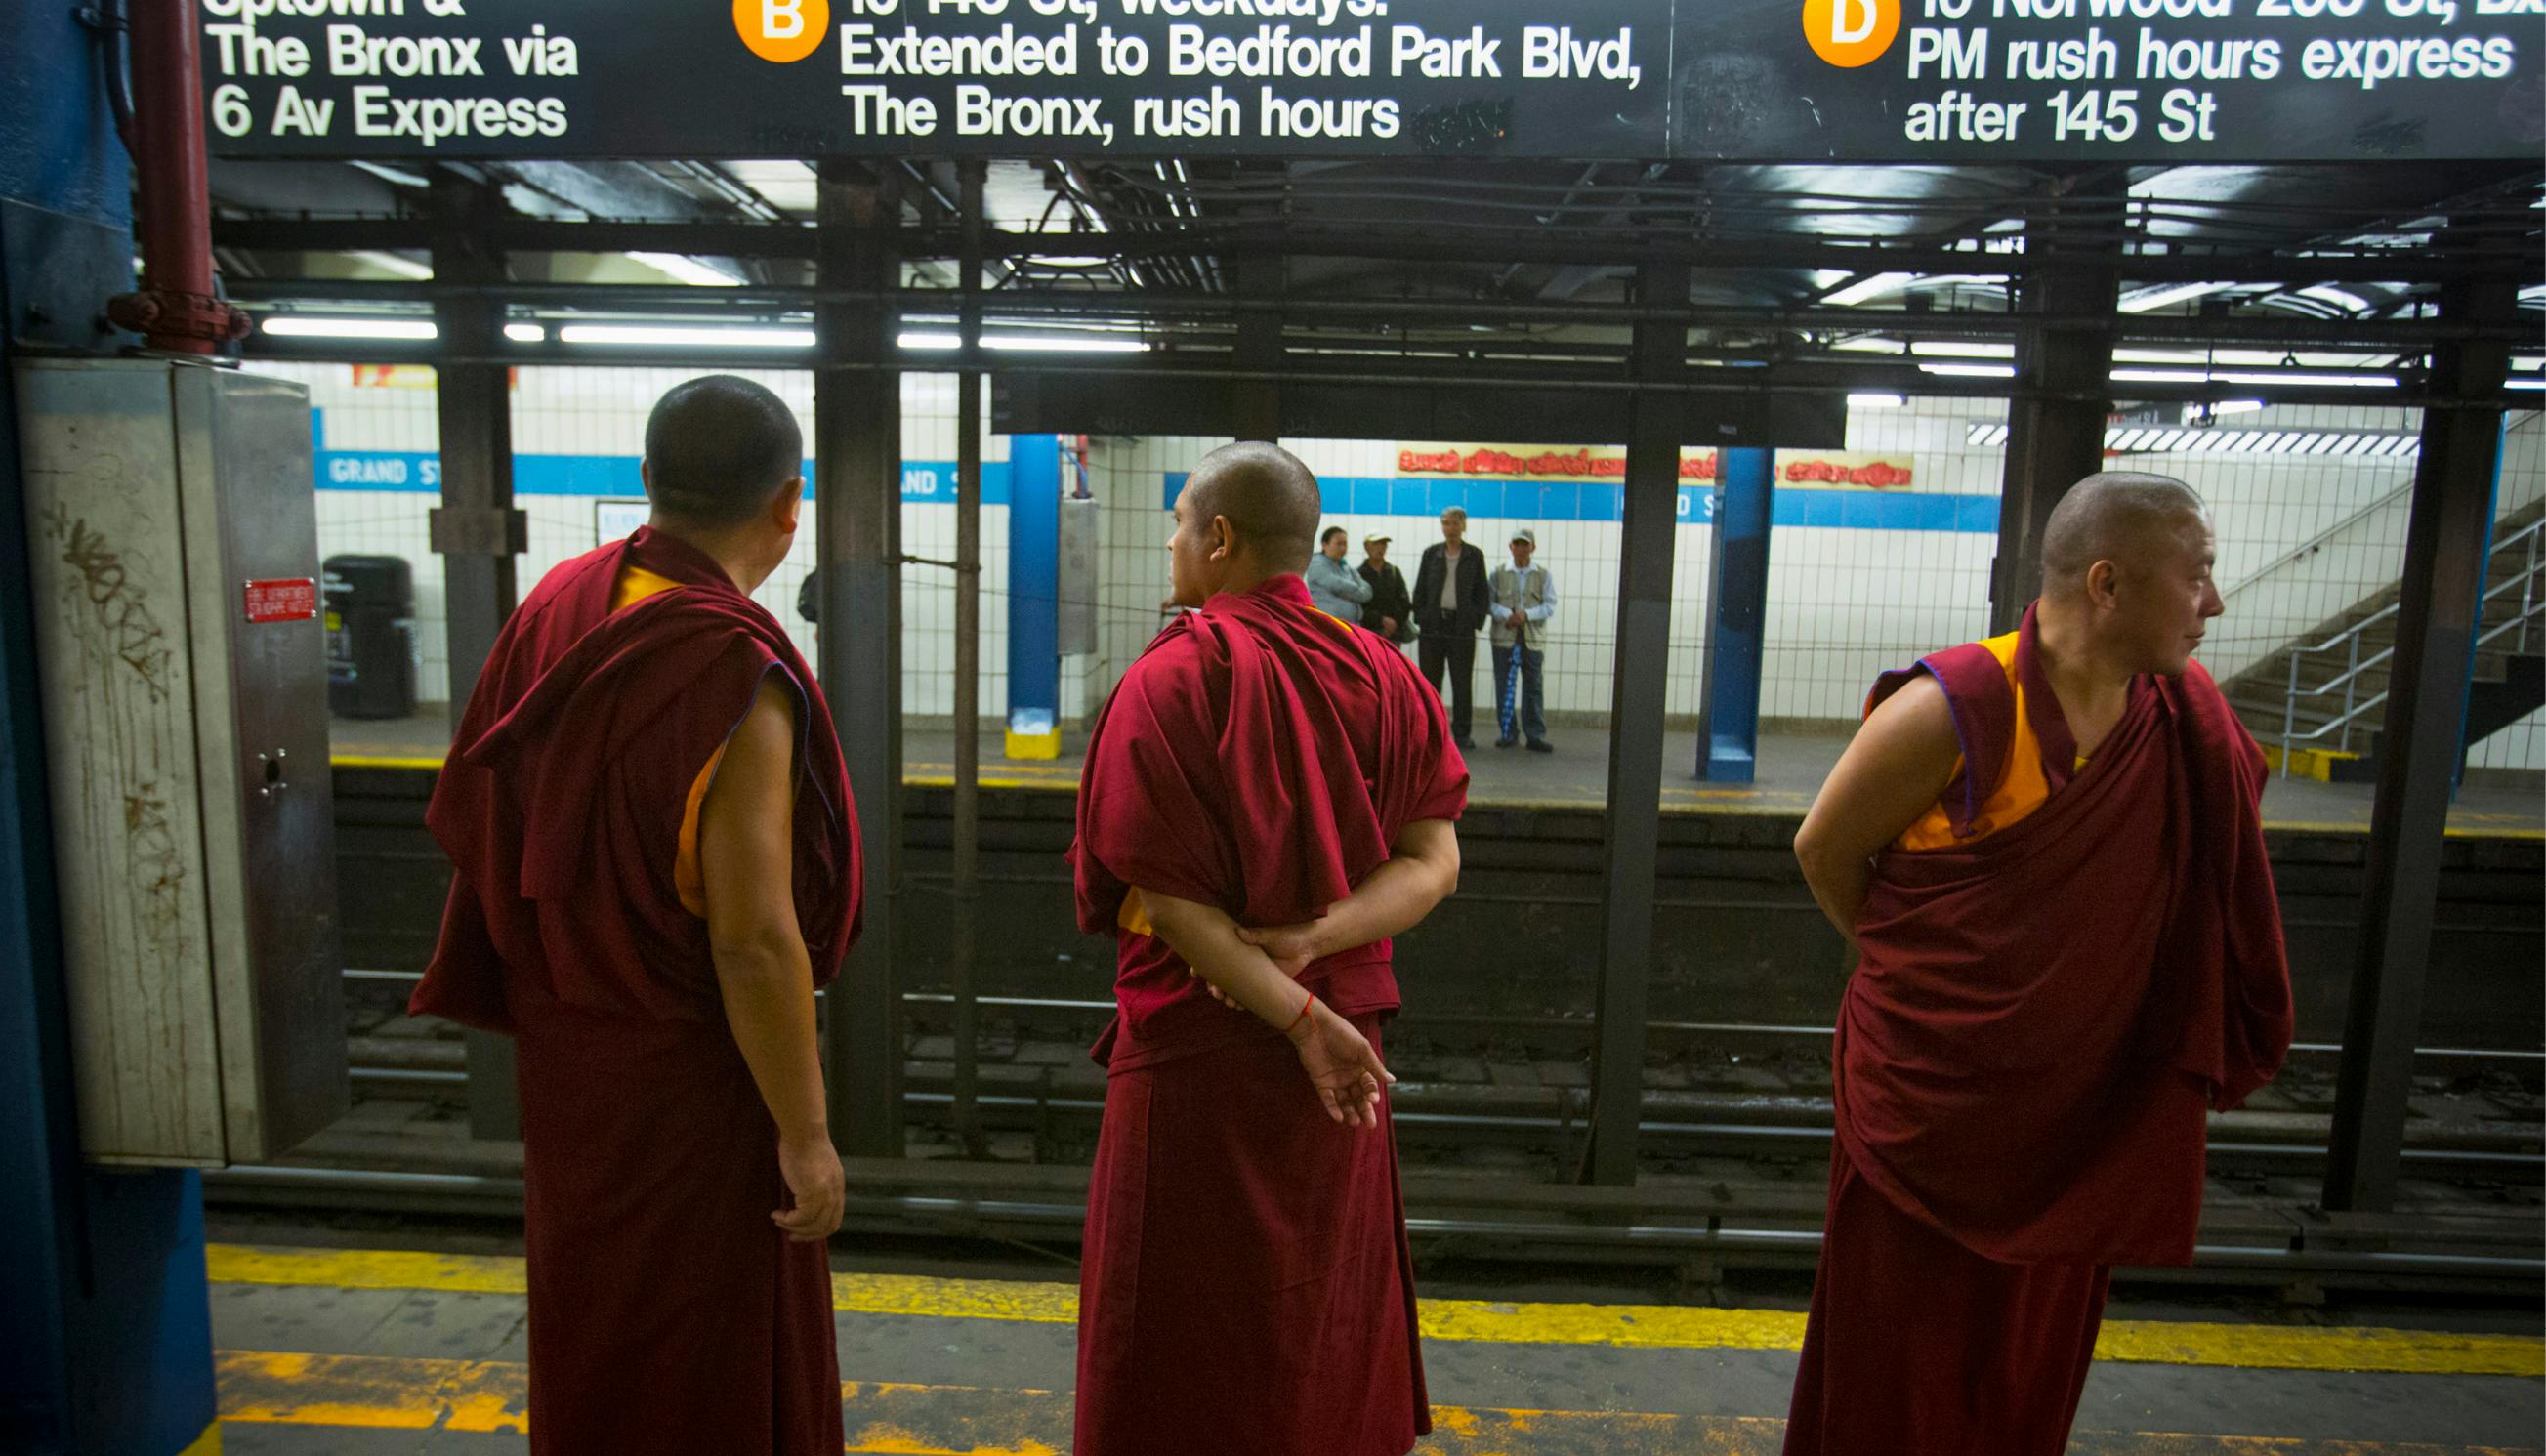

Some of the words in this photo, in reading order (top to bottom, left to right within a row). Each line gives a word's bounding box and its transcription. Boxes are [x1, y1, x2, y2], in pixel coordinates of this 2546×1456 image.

[761, 0, 805, 38] B
[1831, 0, 1878, 43] D
[204, 24, 311, 76] The
[327, 24, 484, 76] Bronx
[502, 23, 579, 76] via
[840, 23, 1078, 76] Extended
[1096, 25, 1149, 76] to
[1168, 24, 1372, 77] Bedford
[1391, 25, 1502, 78] Park
[1522, 25, 1642, 90] Blvd,
[1907, 27, 1989, 80] PM
[2006, 27, 2118, 80] rush
[2136, 27, 2283, 80] hours
[2301, 36, 2515, 90] express
[212, 85, 252, 137] 6
[271, 85, 335, 137] Av
[353, 85, 568, 146] Express
[841, 85, 938, 136] The
[956, 85, 1115, 146] Bronx,
[1134, 86, 1241, 137] rush
[1260, 86, 1401, 139] hours
[1904, 90, 2027, 143] after
[2046, 90, 2139, 142] 145
[2158, 89, 2218, 143] St
[328, 458, 408, 485] GRAND
[418, 459, 441, 486] S
